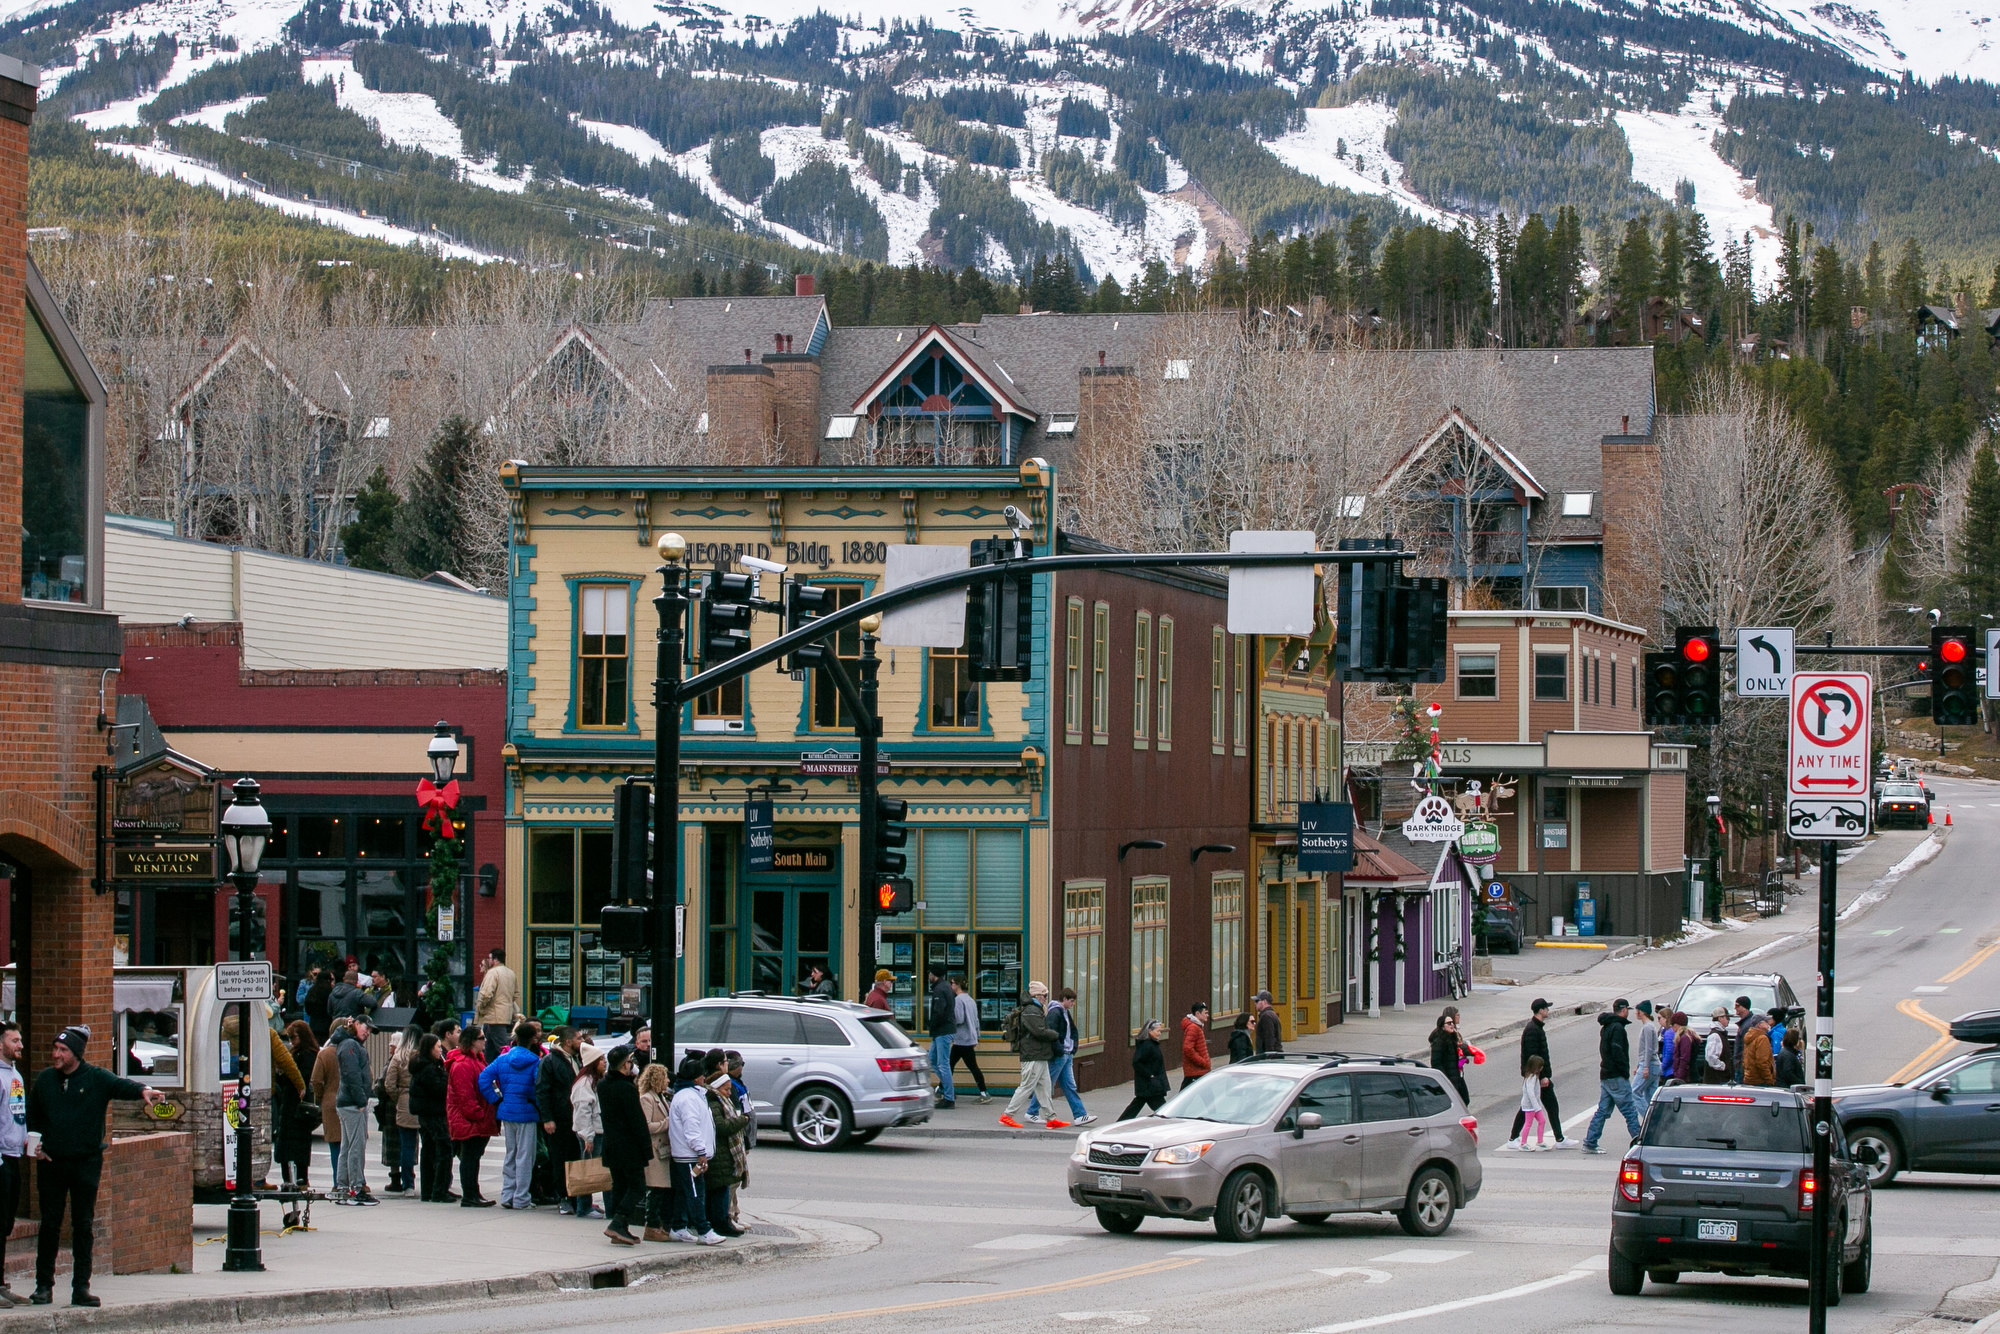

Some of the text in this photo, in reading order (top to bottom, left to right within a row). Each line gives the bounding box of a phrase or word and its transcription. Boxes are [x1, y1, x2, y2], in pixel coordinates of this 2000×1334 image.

[683, 541, 887, 570] HEOBALD Bldg. 1880
[1746, 678, 1787, 691] ONLY
[1797, 755, 1861, 768] ANY TIME
[806, 764, 828, 773] MAIN
[828, 764, 858, 773] STREET
[749, 808, 759, 823] LIV
[1302, 821, 1317, 830] LIV
[750, 831, 773, 849] Sotheby's
[1302, 837, 1348, 849] Sotheby's
[1461, 832, 1496, 845] GLIDE SHOP
[128, 853, 199, 862] VACATION
[774, 852, 827, 866] South Main
[134, 864, 193, 873] RENTALS
[1682, 1170, 1760, 1178] BRONCO
